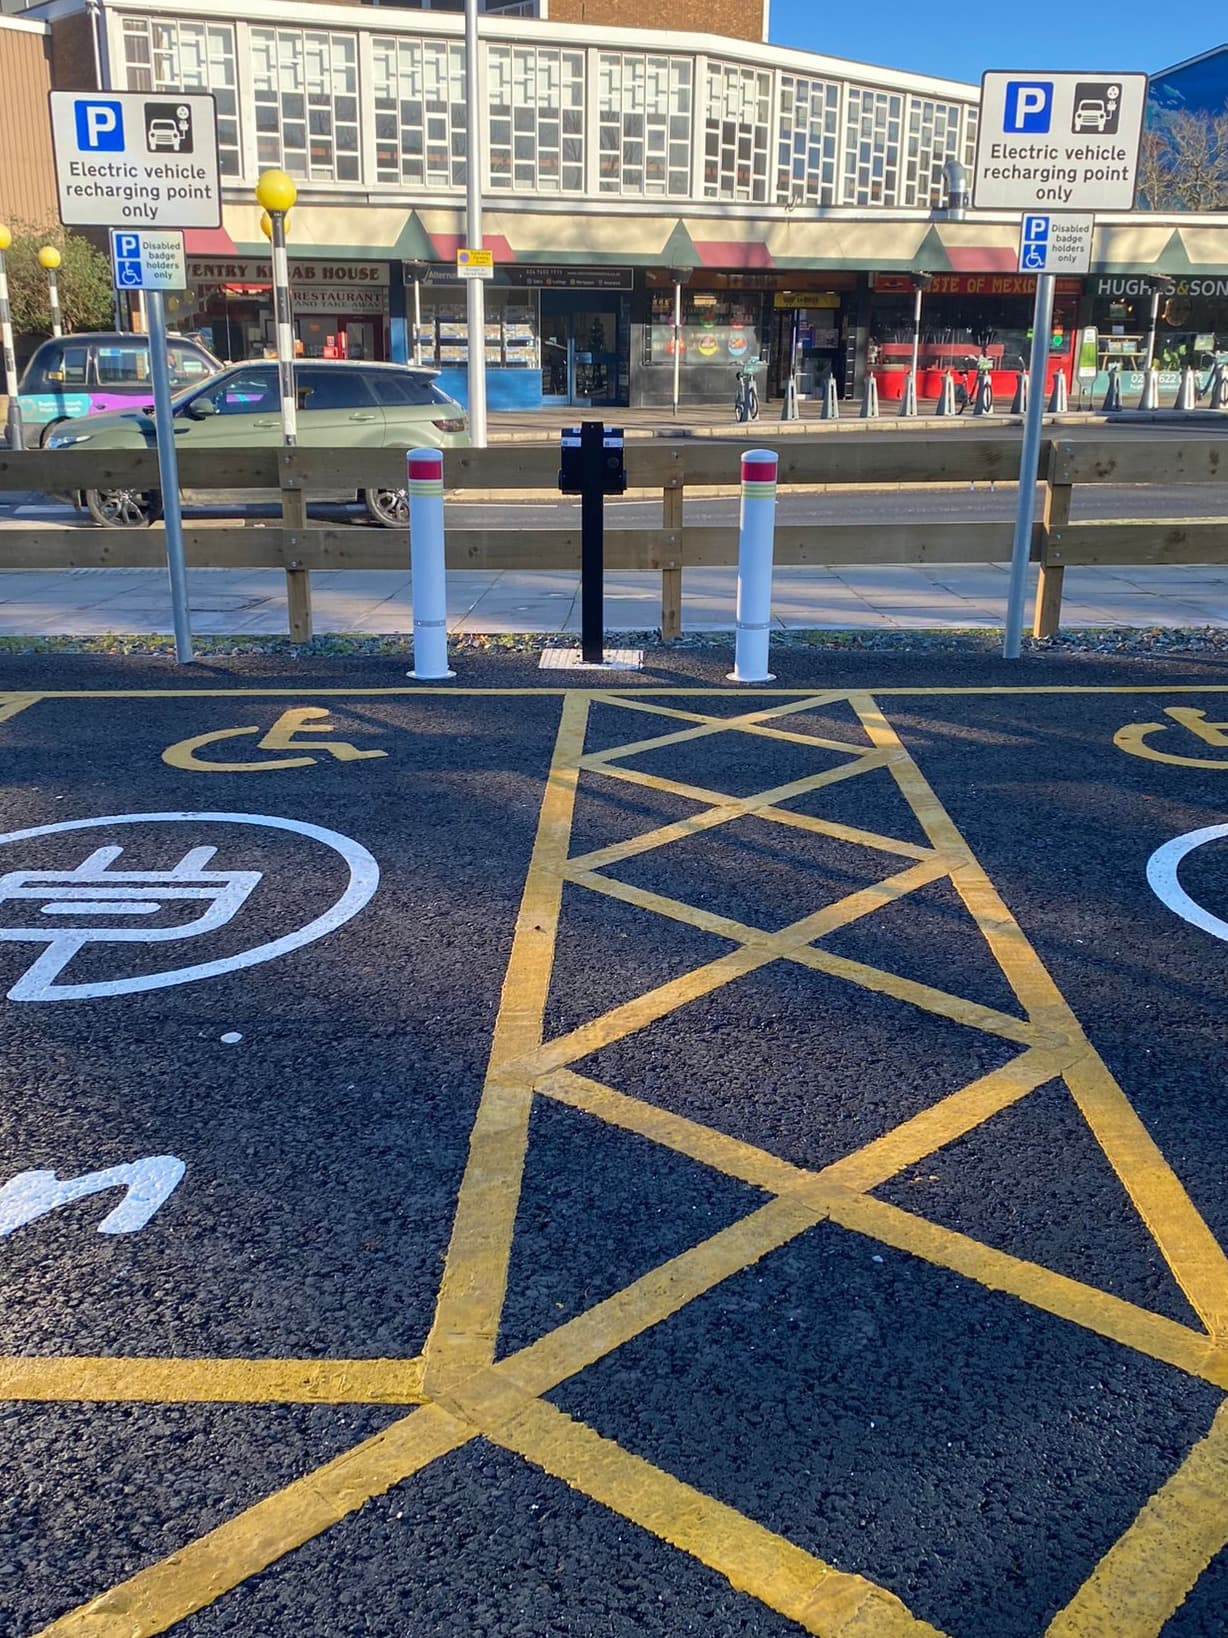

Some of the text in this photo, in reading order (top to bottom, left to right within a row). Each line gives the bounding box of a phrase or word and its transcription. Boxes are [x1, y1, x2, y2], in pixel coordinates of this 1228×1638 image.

[1014, 87, 1046, 129] P
[86, 106, 117, 147] P
[991, 144, 1126, 161] Electric vehicle
[69, 162, 206, 180] Electric vehicle
[983, 166, 1129, 184] recharging point
[66, 183, 212, 201] recharging point
[1035, 186, 1073, 203] only
[122, 203, 159, 220] only
[1031, 219, 1046, 239] P
[1051, 224, 1090, 233] Disabled
[121, 236, 137, 256] P
[143, 241, 181, 250] Disabled
[1056, 234, 1083, 244] badge
[1051, 244, 1085, 252] holders
[148, 252, 176, 261] badge
[1058, 254, 1077, 263] only
[146, 261, 180, 269] holders
[153, 271, 173, 280] only
[255, 266, 315, 280] KAB
[322, 267, 380, 281] HOUSE
[925, 276, 1036, 293] STE OF MEXIC
[293, 292, 382, 302] RESTAURANT
[1159, 374, 1177, 384] 622
